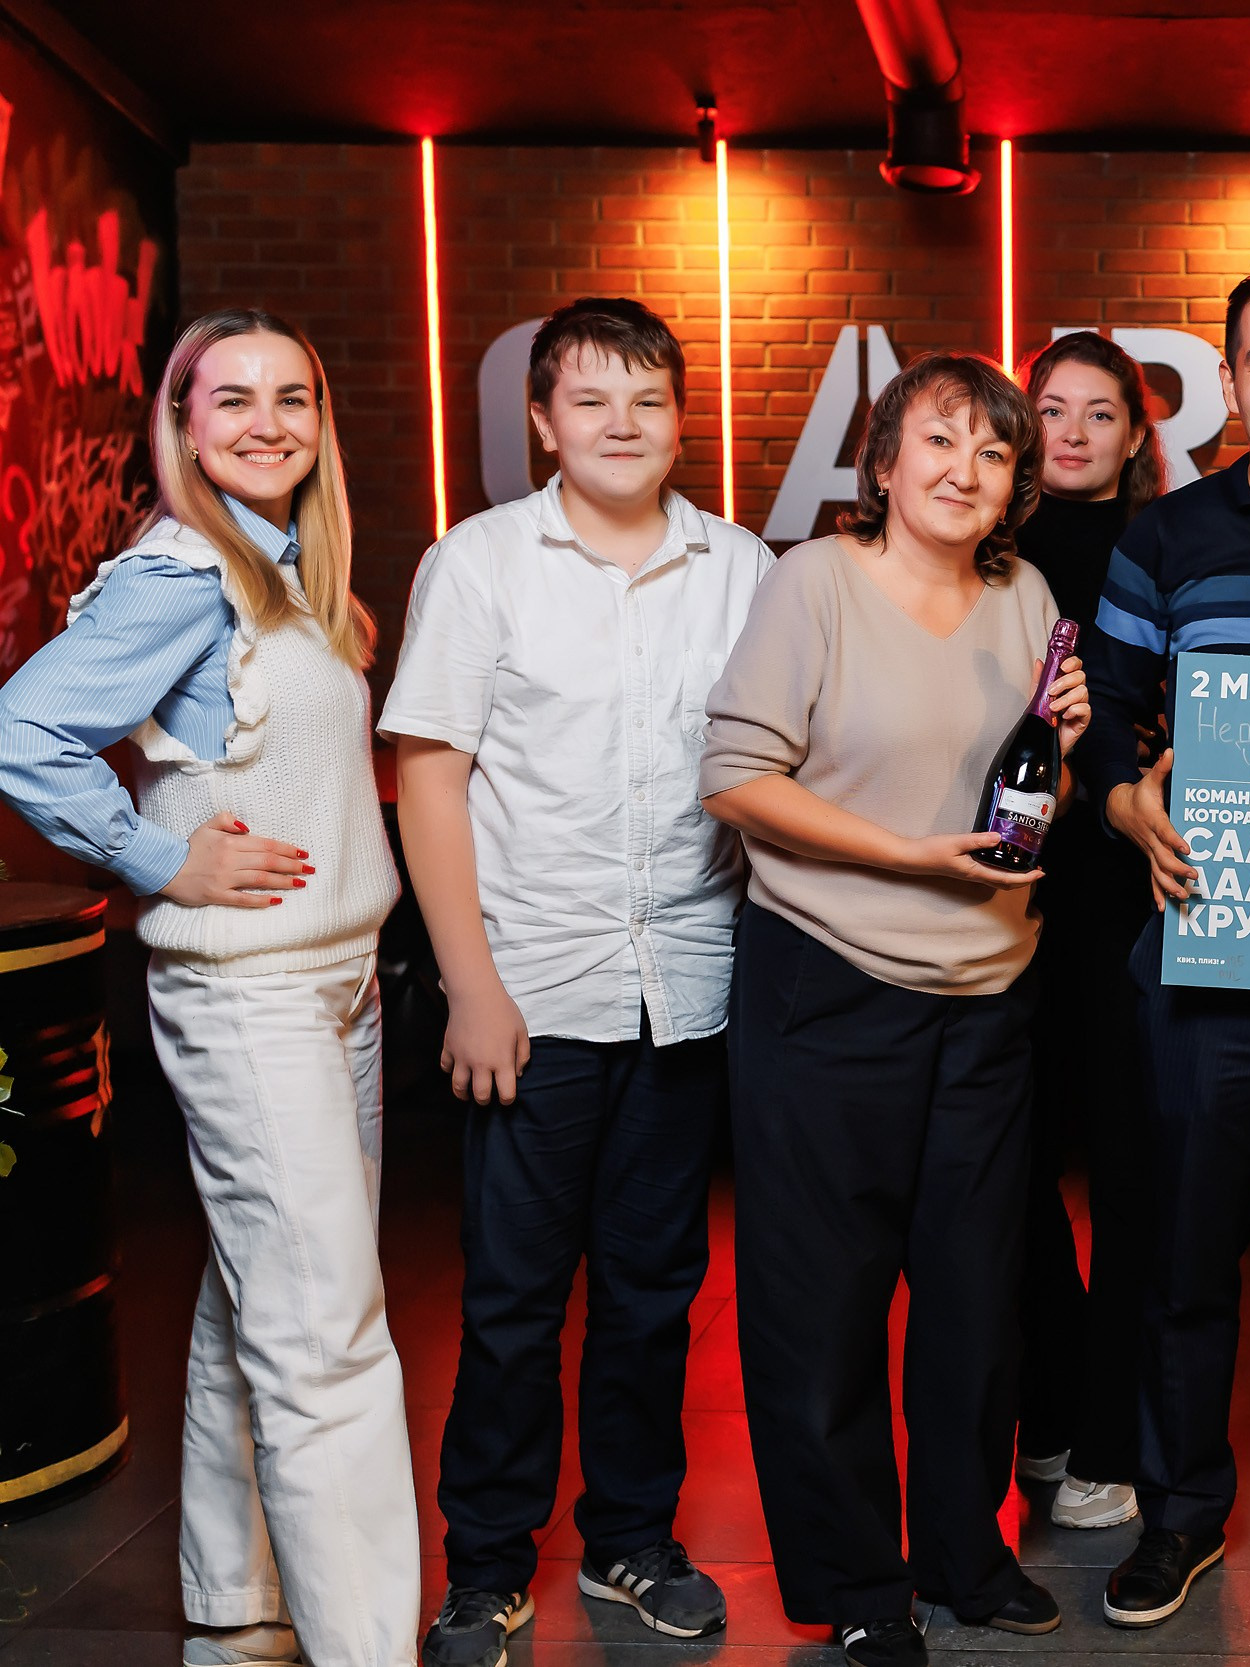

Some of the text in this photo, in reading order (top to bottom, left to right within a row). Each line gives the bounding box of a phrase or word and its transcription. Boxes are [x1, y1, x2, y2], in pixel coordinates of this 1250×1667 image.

[1190, 670, 1210, 698] 2
[1007, 811, 1036, 827] SANTO
[1176, 956, 1197, 965] КВИЗ,
[1198, 957, 1219, 965] ПЛИЗ!
